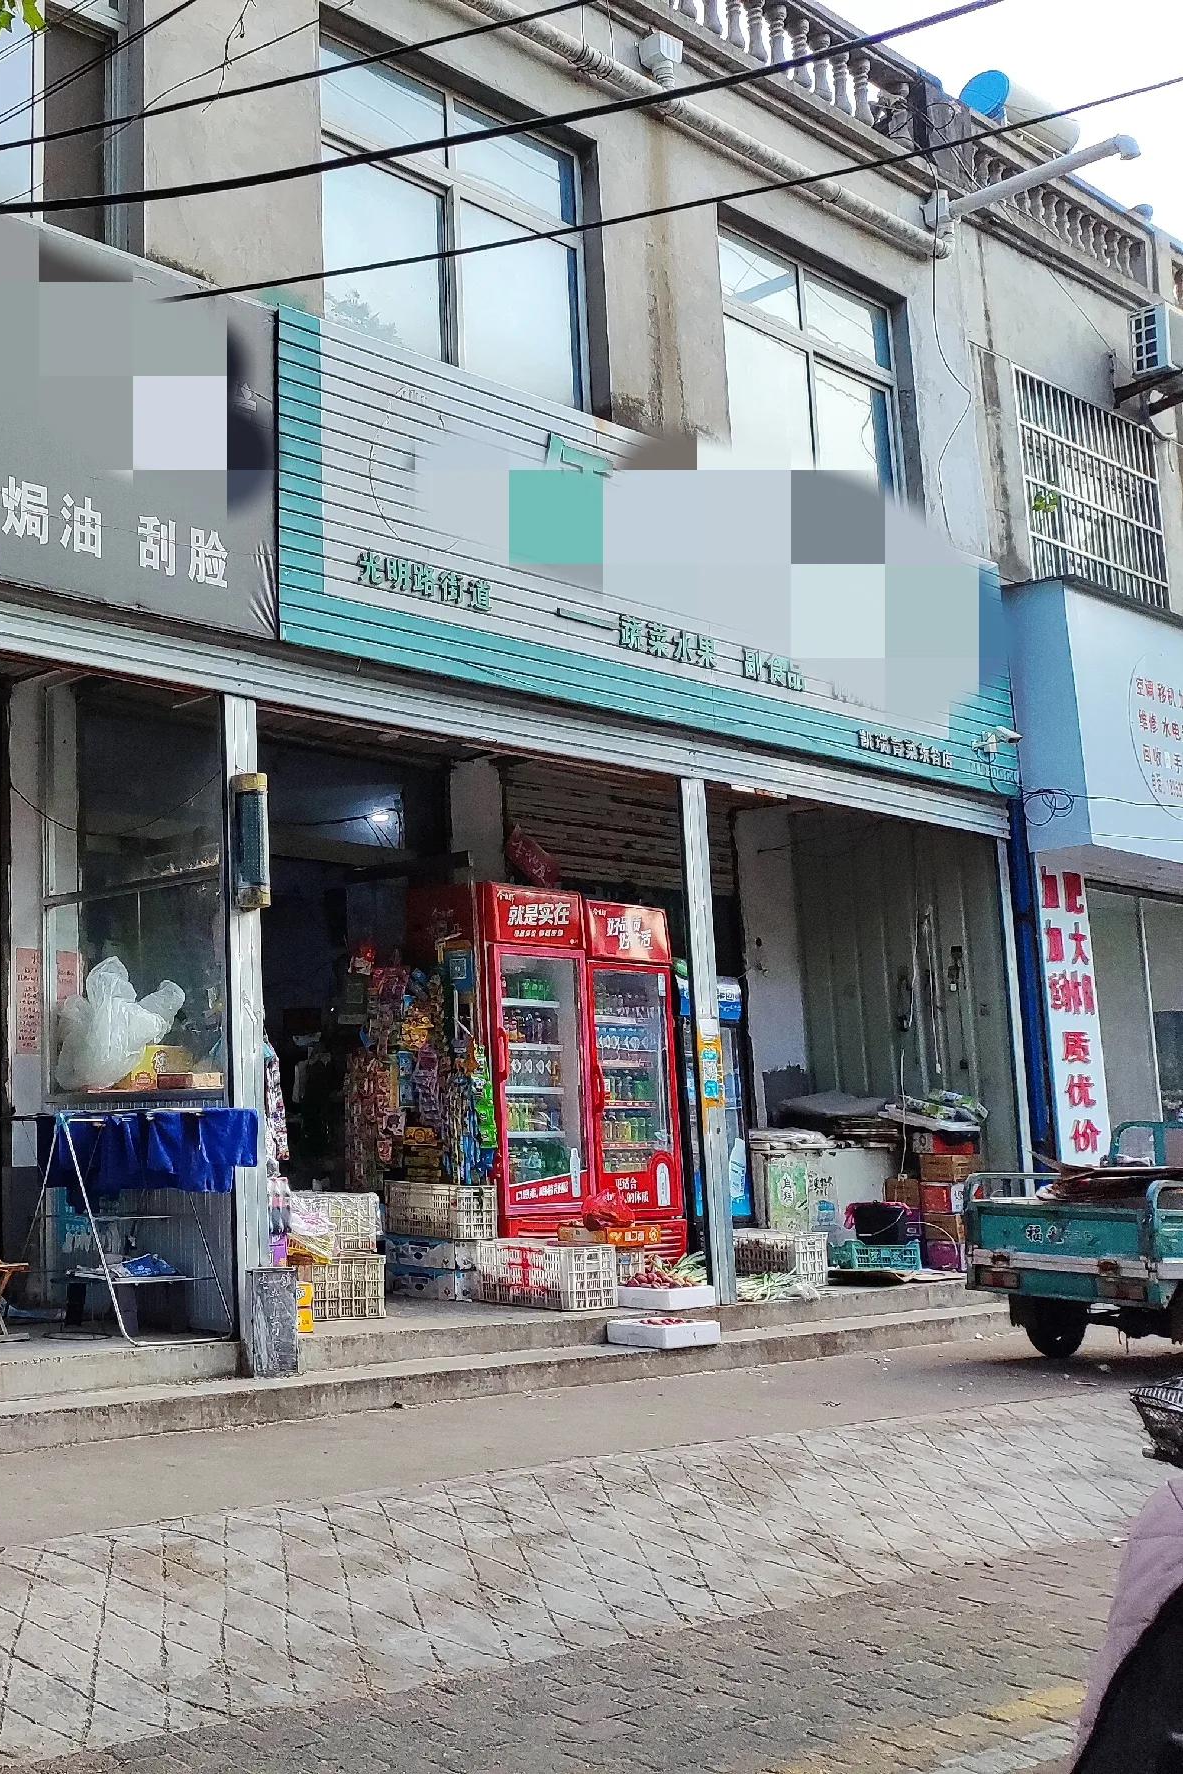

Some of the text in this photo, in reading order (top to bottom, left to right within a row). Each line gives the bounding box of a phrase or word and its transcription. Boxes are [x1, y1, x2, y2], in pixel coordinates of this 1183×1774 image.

[1, 476, 103, 559] 焗油
[136, 515, 229, 589] 刮脸
[357, 551, 492, 611] 光明路街道
[507, 901, 571, 926] 就是实在
